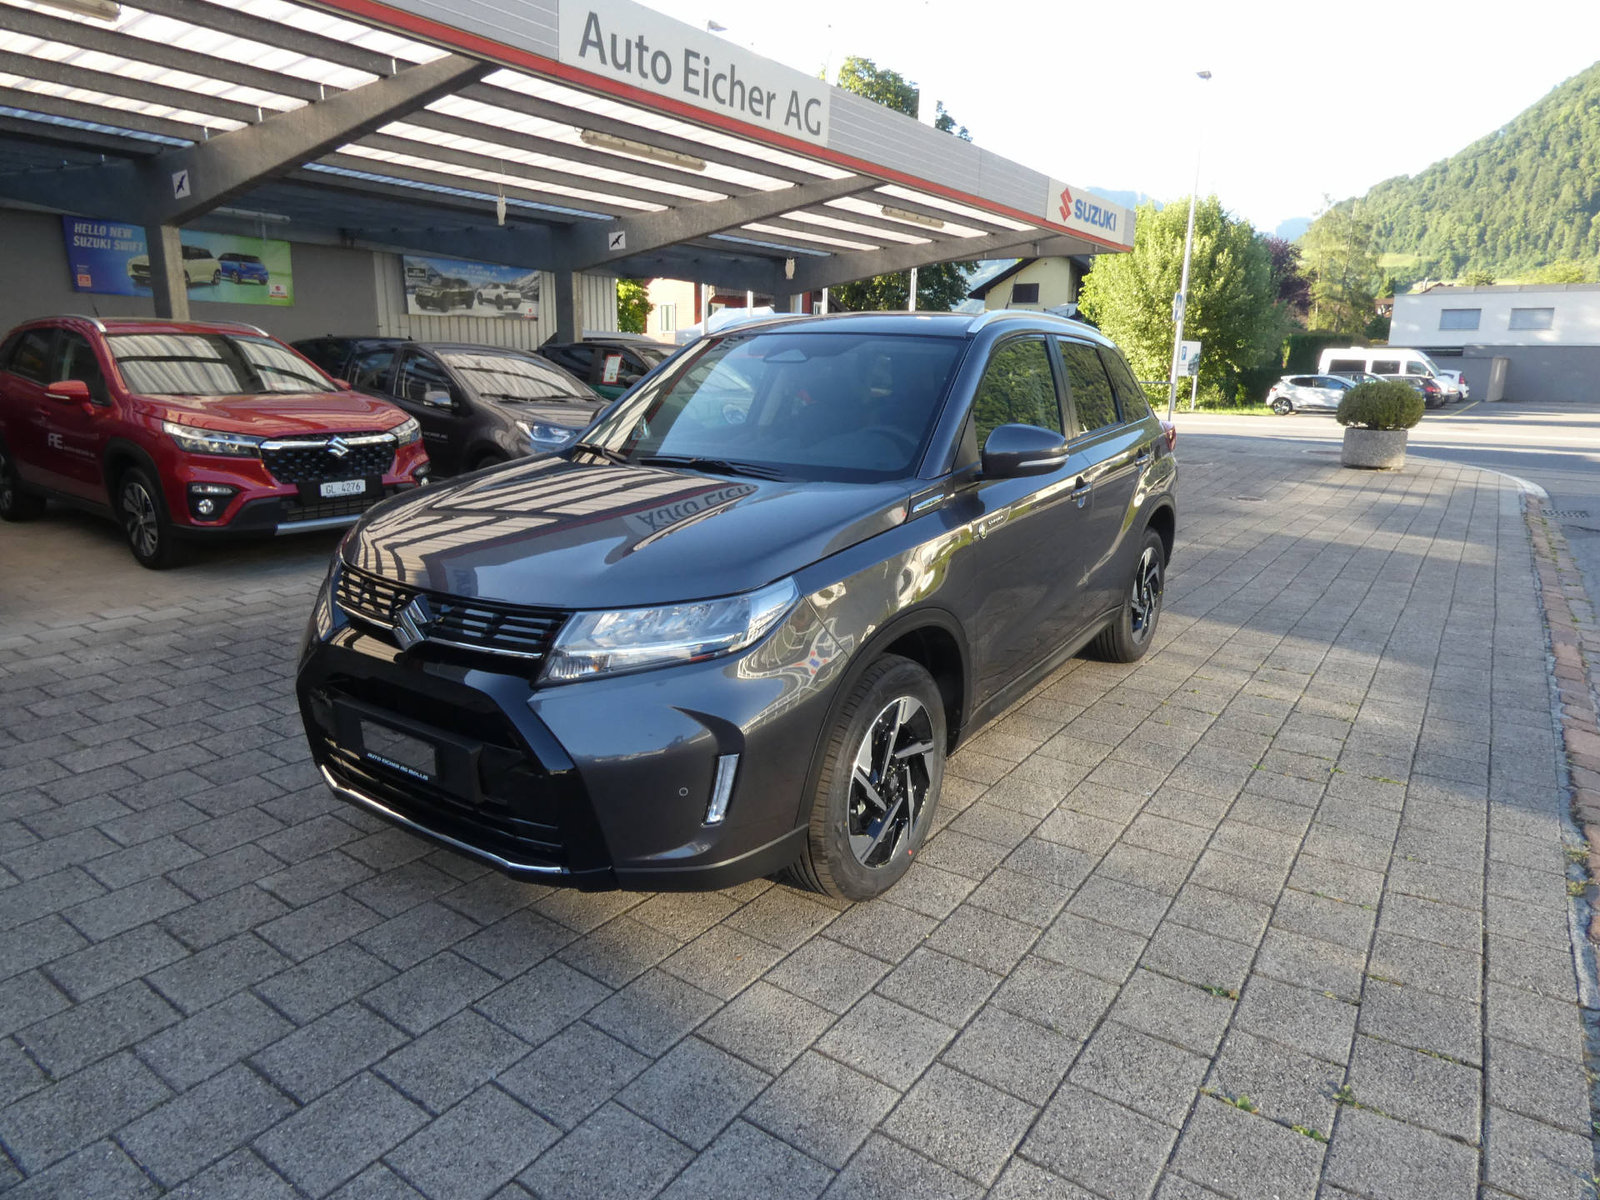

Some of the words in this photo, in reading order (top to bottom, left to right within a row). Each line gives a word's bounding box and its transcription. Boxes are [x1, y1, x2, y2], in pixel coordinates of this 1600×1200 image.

[578, 11, 671, 85] Auto
[683, 48, 776, 120] Eicher
[784, 90, 821, 136] AG
[1074, 199, 1117, 232] SUZUKI
[74, 223, 107, 236] HELLO
[110, 227, 132, 238] NEW
[73, 236, 111, 249] SUZUKI
[114, 240, 144, 252] SWIFT
[341, 481, 361, 492] 4276
